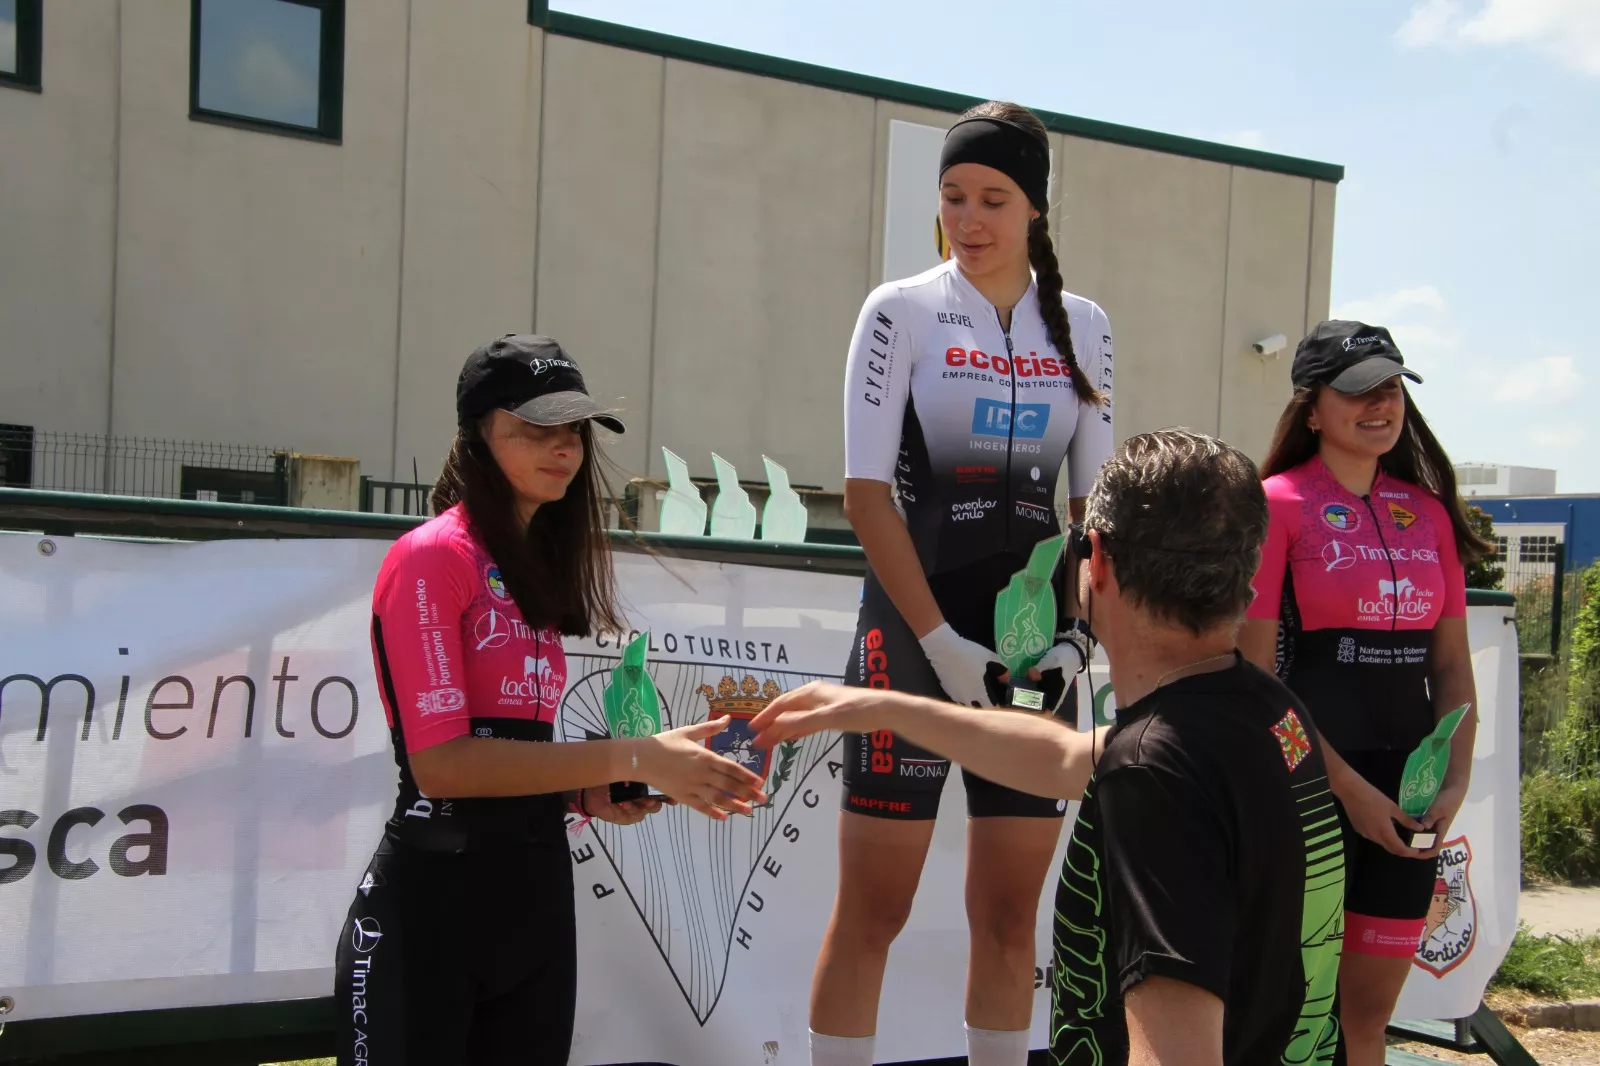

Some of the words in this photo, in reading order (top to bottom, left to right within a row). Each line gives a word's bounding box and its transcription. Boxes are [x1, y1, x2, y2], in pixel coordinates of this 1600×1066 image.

[1356, 335, 1379, 345] Timac
[546, 358, 570, 368] Timac
[864, 311, 893, 407] CYCLON
[945, 347, 1073, 377] ecotisa
[942, 371, 994, 383] EMPRESA
[999, 378, 1074, 390] CONSTRUCTOR
[986, 406, 1038, 431] IDC
[969, 440, 1041, 454] INGENIEROS
[1356, 545, 1409, 560] Timac
[416, 579, 429, 625] Iruñeko
[1358, 598, 1432, 615] lacturale
[432, 631, 453, 686] Pamplona
[0, 647, 359, 742] miento
[850, 796, 912, 813] MAPFRE
[736, 759, 843, 951] HUESCA
[352, 955, 372, 1025] Timac
